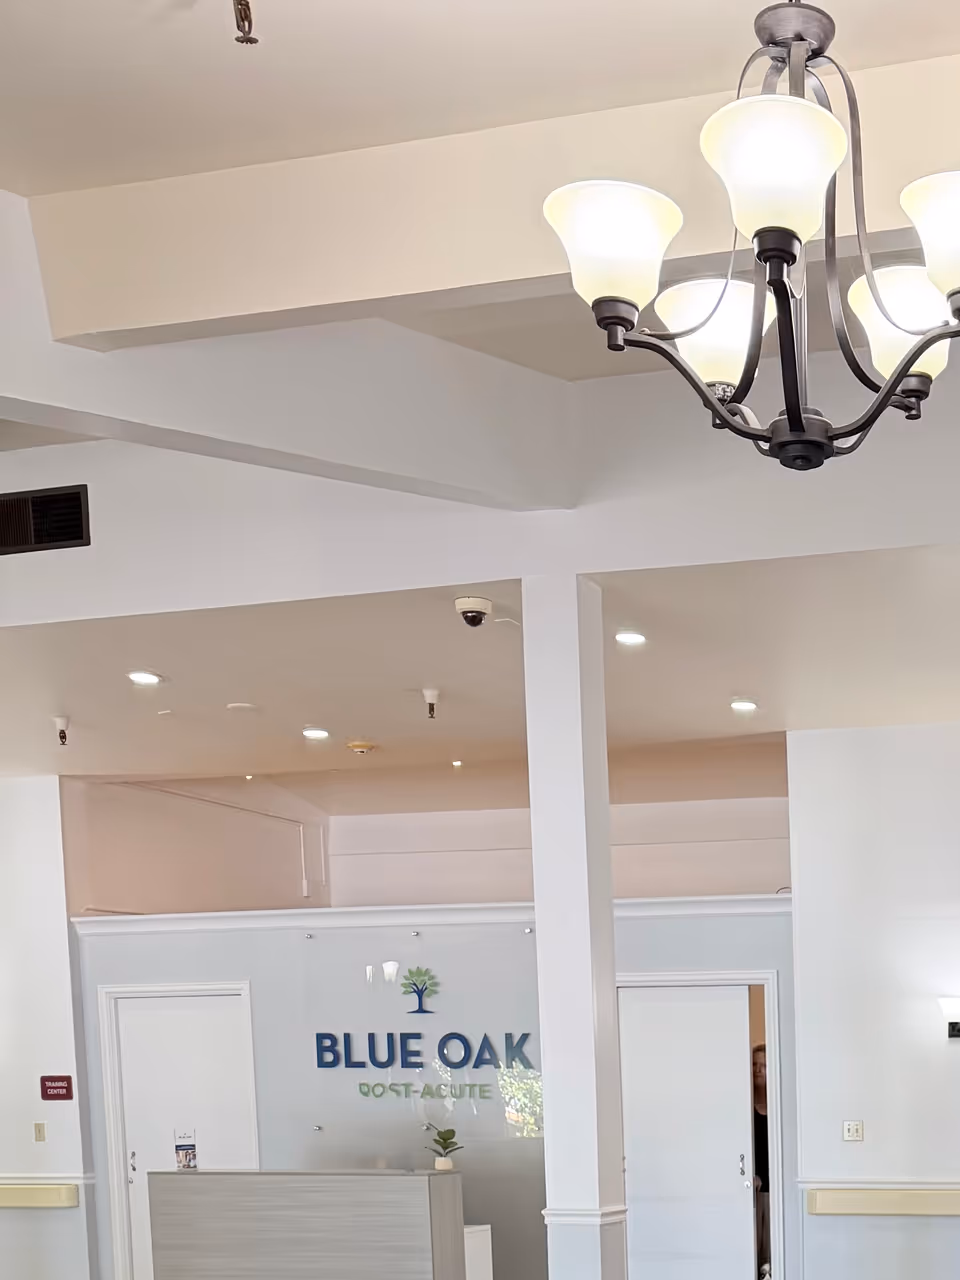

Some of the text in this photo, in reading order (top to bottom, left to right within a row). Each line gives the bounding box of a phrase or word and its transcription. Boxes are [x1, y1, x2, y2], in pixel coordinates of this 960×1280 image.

[315, 1032, 536, 1070] BLUE OAK
[358, 1082, 493, 1100] POST-ACUTE
